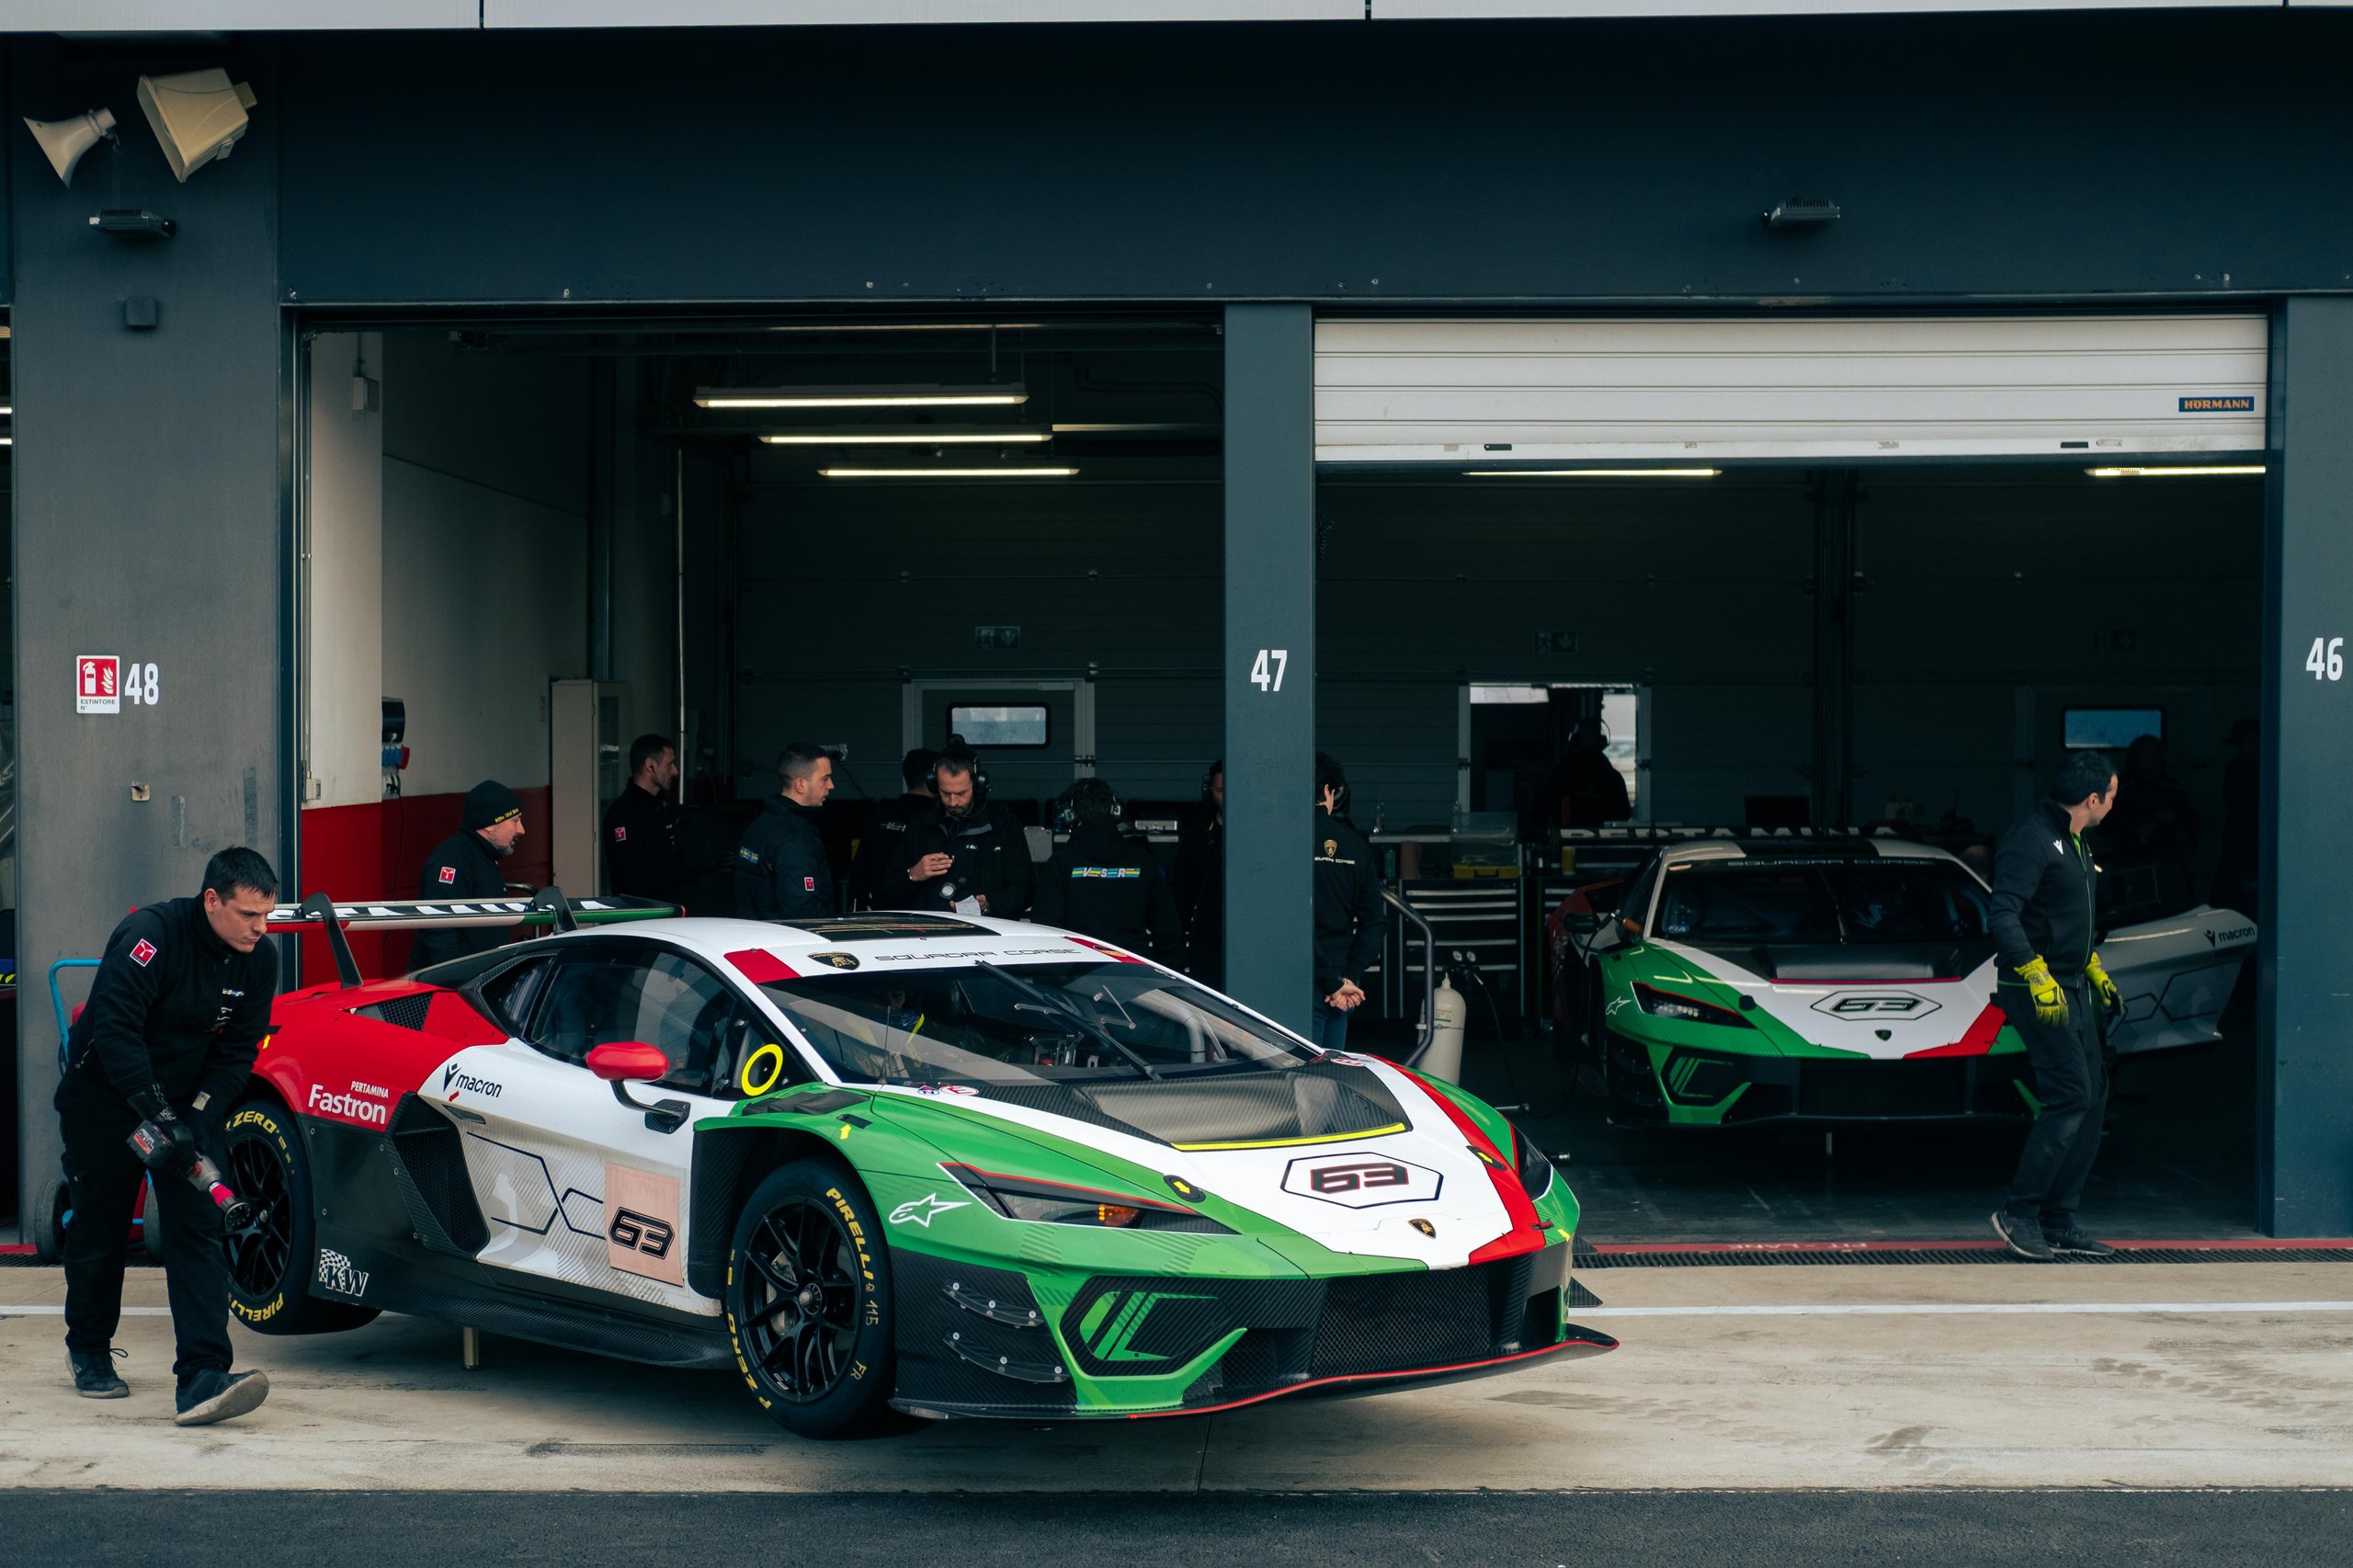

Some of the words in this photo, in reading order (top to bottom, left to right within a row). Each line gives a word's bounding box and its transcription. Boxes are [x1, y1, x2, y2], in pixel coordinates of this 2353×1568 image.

[1250, 649, 1288, 692] 47
[2305, 637, 2344, 681] 46
[124, 663, 159, 706] 48
[2218, 926, 2256, 942] macron
[874, 950, 998, 961] SQUADRA
[1003, 949, 1083, 957] CORSE
[1829, 997, 1924, 1013] 63
[350, 1080, 389, 1099] PERTAMINA
[455, 1074, 503, 1098] macron
[308, 1084, 386, 1125] Fastron
[233, 1110, 278, 1134] ZERO
[1310, 1162, 1409, 1194] 63
[608, 1206, 676, 1260] 63
[825, 1187, 875, 1280] PIRELLI
[325, 1265, 369, 1297] KW
[230, 1291, 284, 1322] PIRELLI
[865, 1300, 880, 1326] 115
[726, 1312, 758, 1392] ZERO
